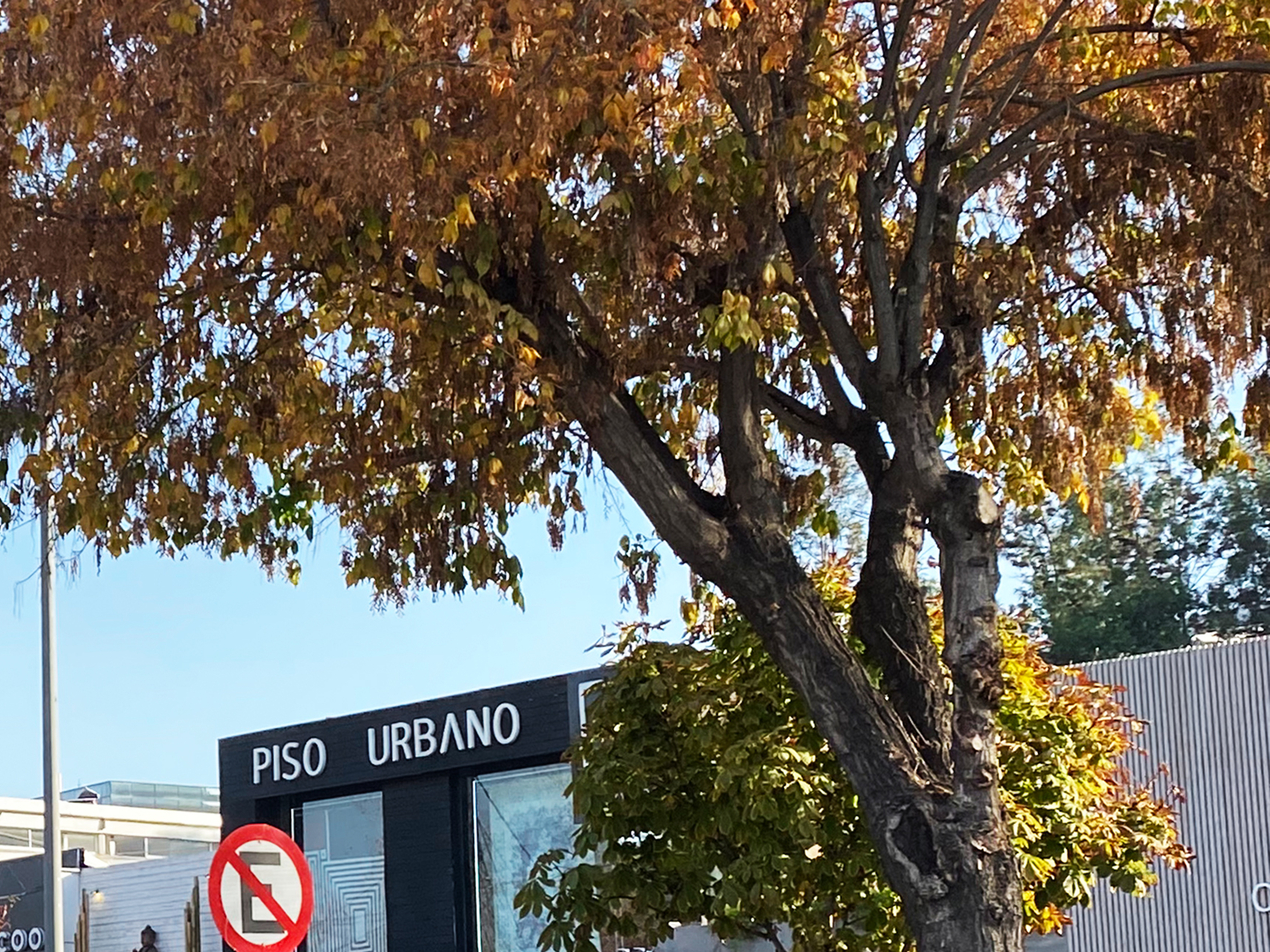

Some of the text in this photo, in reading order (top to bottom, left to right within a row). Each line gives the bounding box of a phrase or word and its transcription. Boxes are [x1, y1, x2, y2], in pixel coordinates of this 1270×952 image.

[252, 702, 521, 785] PISO URBANO
[239, 851, 285, 933] E
